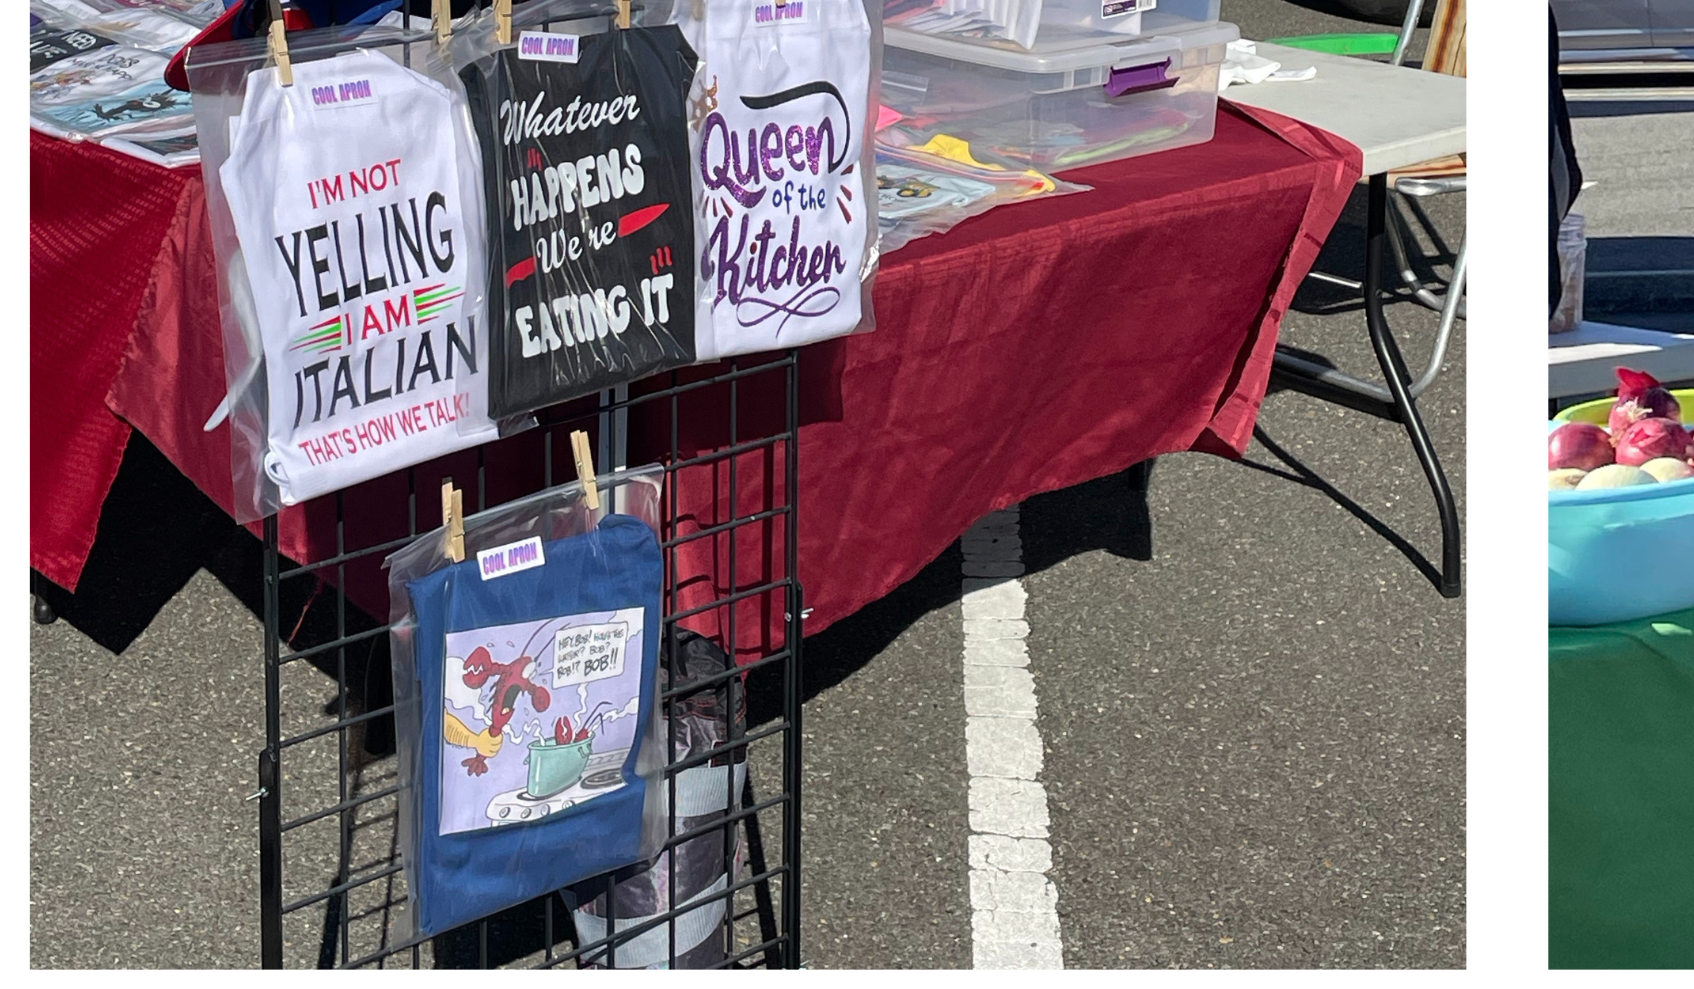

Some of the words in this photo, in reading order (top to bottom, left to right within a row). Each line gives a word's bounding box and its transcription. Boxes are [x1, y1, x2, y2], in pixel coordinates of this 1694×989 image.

[755, 5, 773, 23] COOL
[775, 1, 804, 21] APRON
[520, 36, 544, 55] COOL
[545, 37, 575, 57] APRON
[311, 85, 339, 106] COOL
[338, 79, 373, 102] APRON
[499, 91, 641, 146] Whatever
[307, 175, 346, 210] I'M
[349, 158, 402, 198] NOT
[701, 105, 842, 209] Queen
[511, 143, 645, 232] HAPPENS
[772, 180, 794, 214] of
[798, 184, 826, 210] the
[275, 190, 456, 318] YELLING
[700, 213, 847, 314] Kitchen
[344, 313, 353, 346] I
[360, 294, 412, 341] AM
[515, 284, 631, 359] EATING
[640, 272, 674, 328] IT
[292, 314, 479, 431] ITALIAN
[298, 428, 357, 466] THAT'S
[354, 412, 397, 450] HOW
[396, 402, 427, 437] WE
[424, 391, 470, 429] TALK!
[483, 551, 506, 576] COOL
[508, 542, 538, 568] APRON
